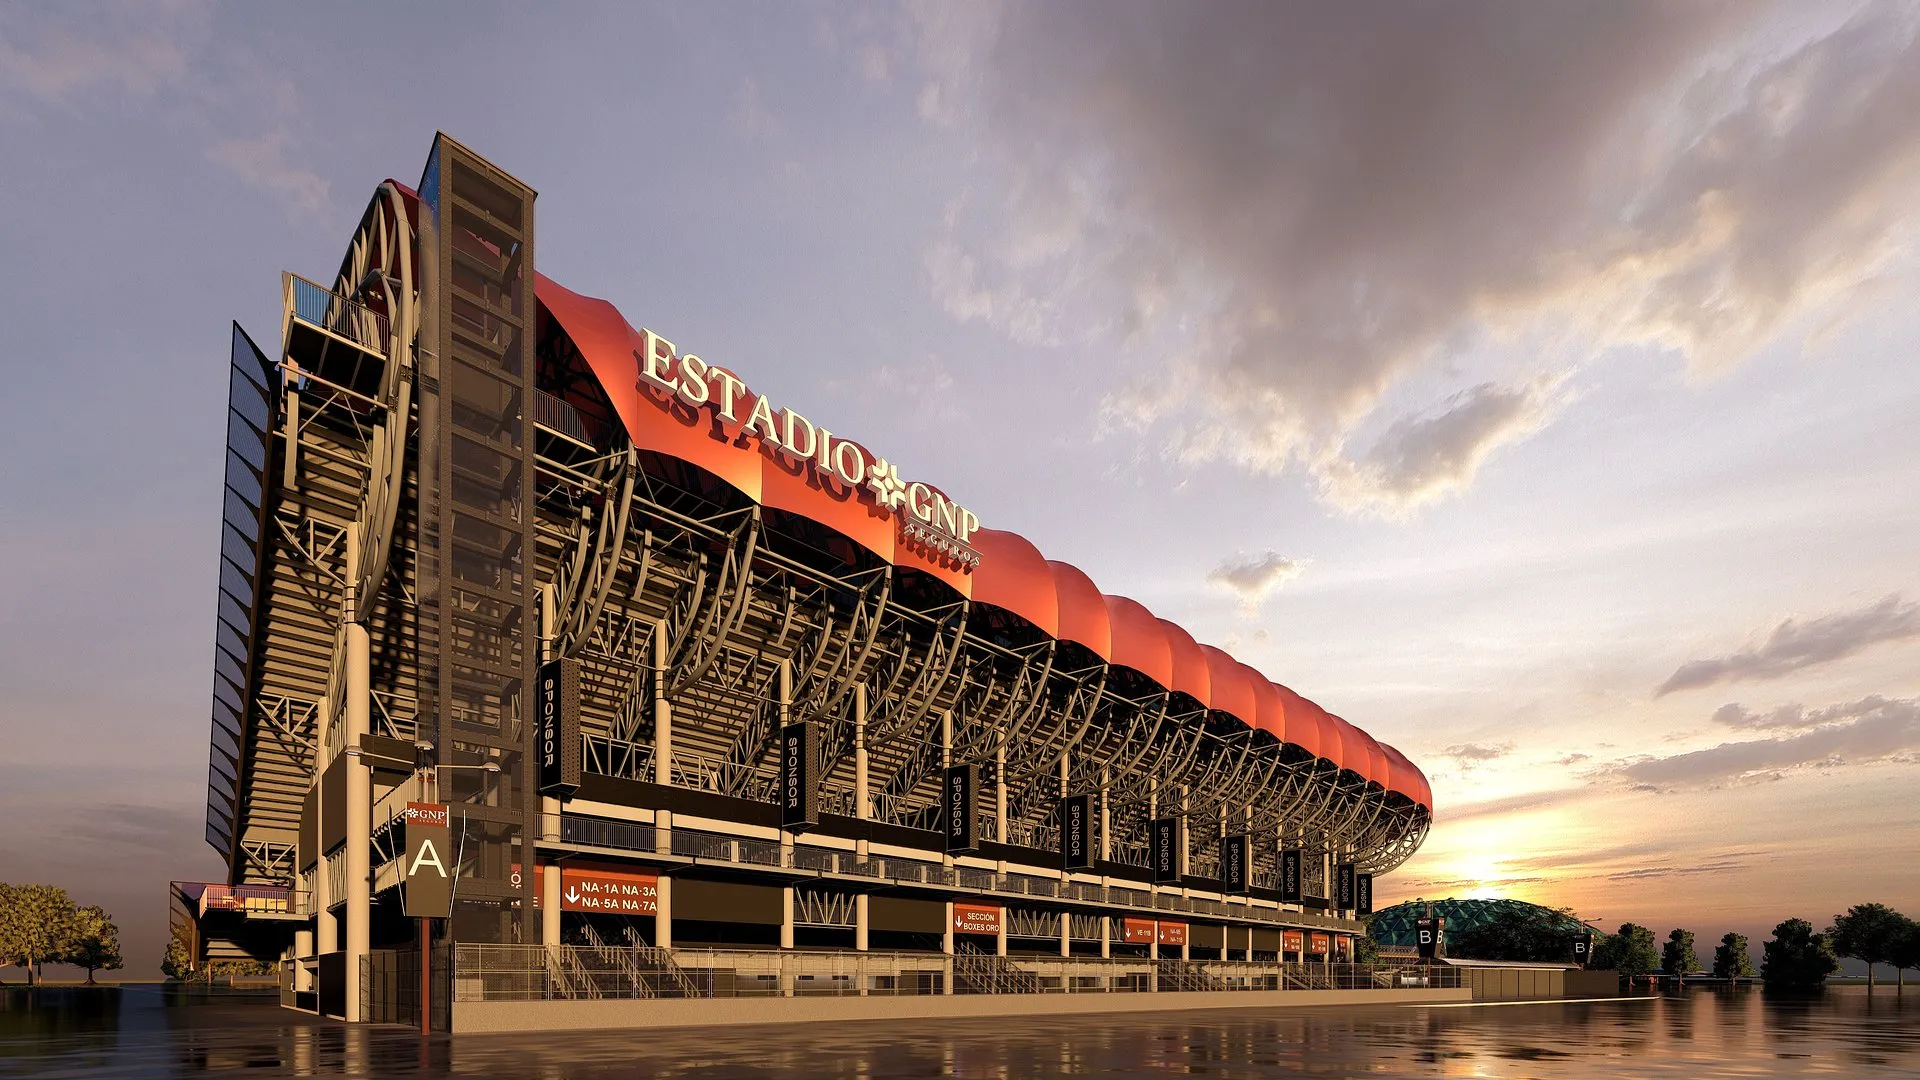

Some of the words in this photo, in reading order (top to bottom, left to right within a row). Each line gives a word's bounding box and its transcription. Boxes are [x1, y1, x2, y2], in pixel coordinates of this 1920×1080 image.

[639, 327, 865, 488] ESTADIO
[905, 482, 980, 545] GNP
[904, 523, 980, 568] SEGUROS
[544, 678, 554, 768] SPONSOR
[788, 736, 798, 809] SPONSOR
[419, 809, 446, 820] GNP
[952, 776, 962, 837] SPONSOR
[1071, 805, 1080, 857] SPONSOR
[1160, 826, 1169, 872] SPONSOR
[408, 839, 447, 878] A
[1230, 843, 1239, 885] SPONSOR
[963, 922, 985, 931] BOXES
[985, 924, 1000, 932] ORO
[967, 912, 995, 922] SECCIÓN
[1420, 930, 1431, 944] B
[1436, 930, 1443, 943] B
[1575, 942, 1585, 953] B
